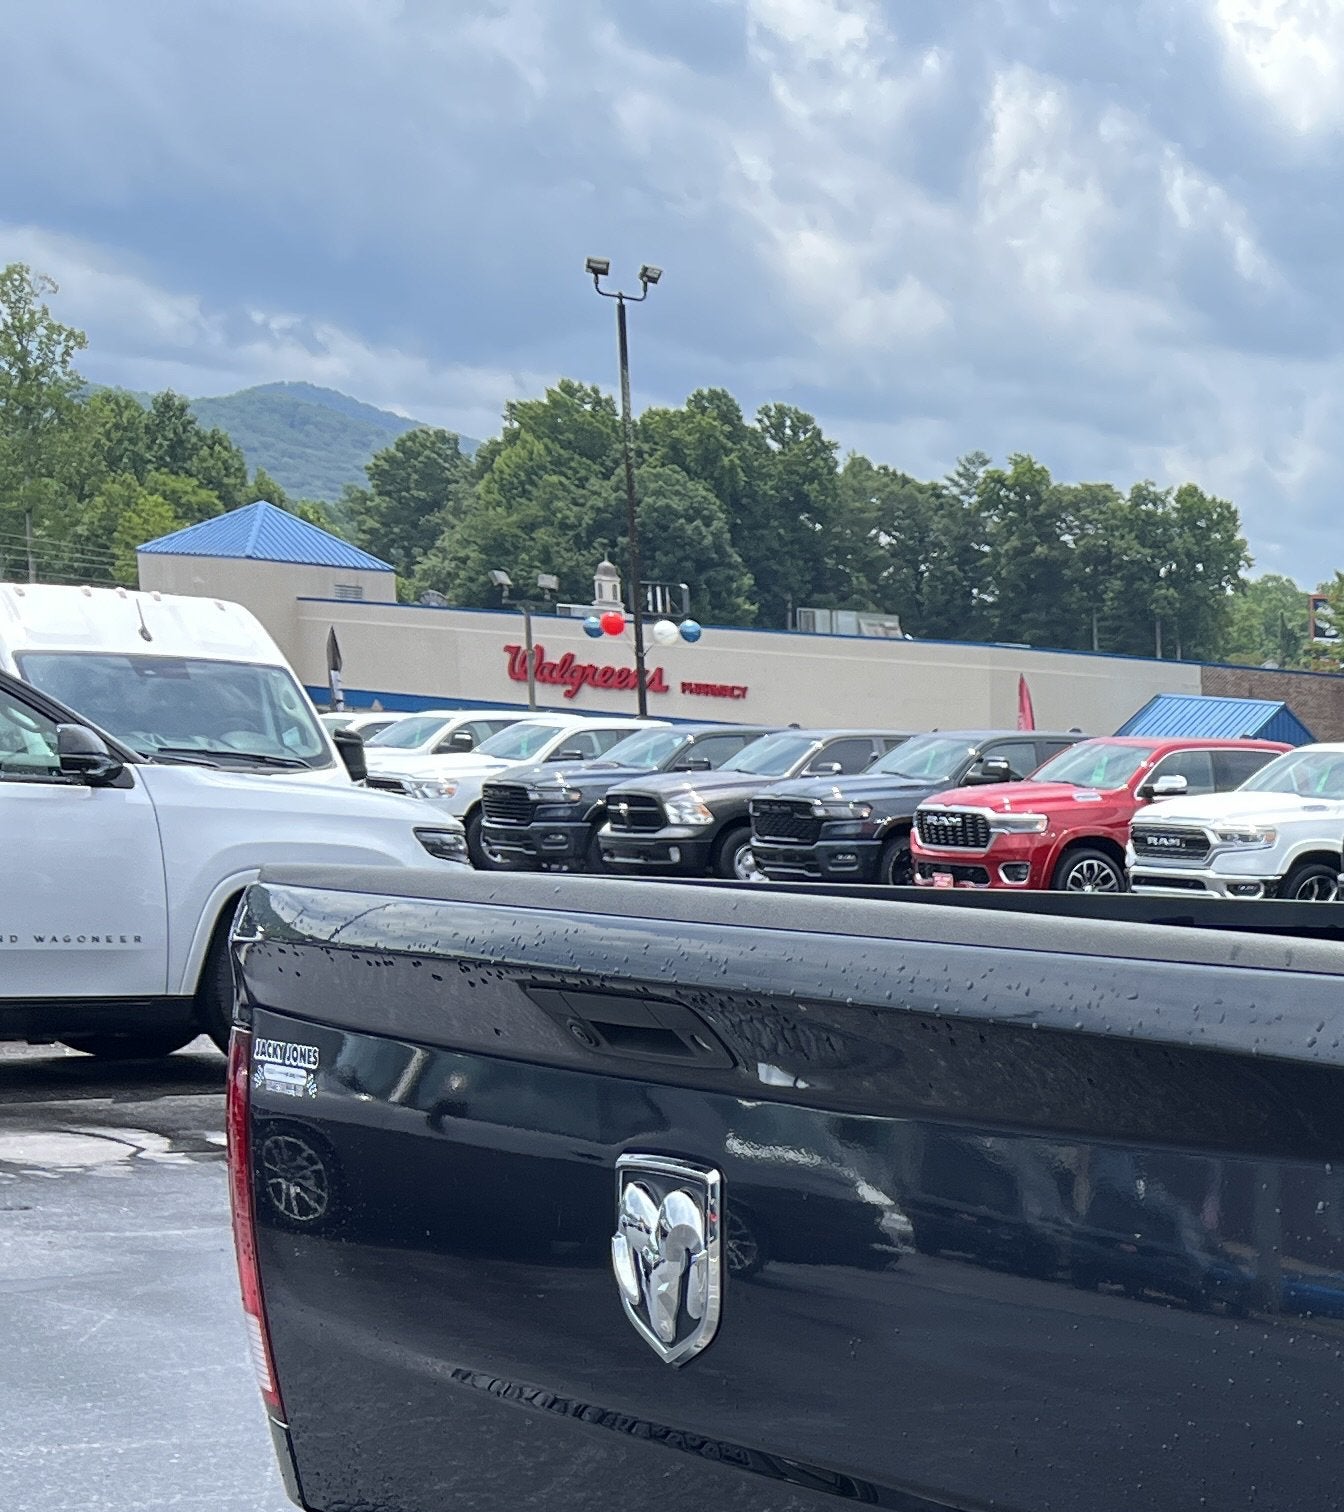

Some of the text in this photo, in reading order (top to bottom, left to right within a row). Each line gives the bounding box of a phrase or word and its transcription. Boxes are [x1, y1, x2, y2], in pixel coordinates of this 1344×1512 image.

[504, 644, 748, 699] Walgreens PHARMACY
[927, 815, 962, 826] RAM
[33, 935, 142, 943] WAGONEER
[256, 1039, 318, 1066] JACKY JONES
